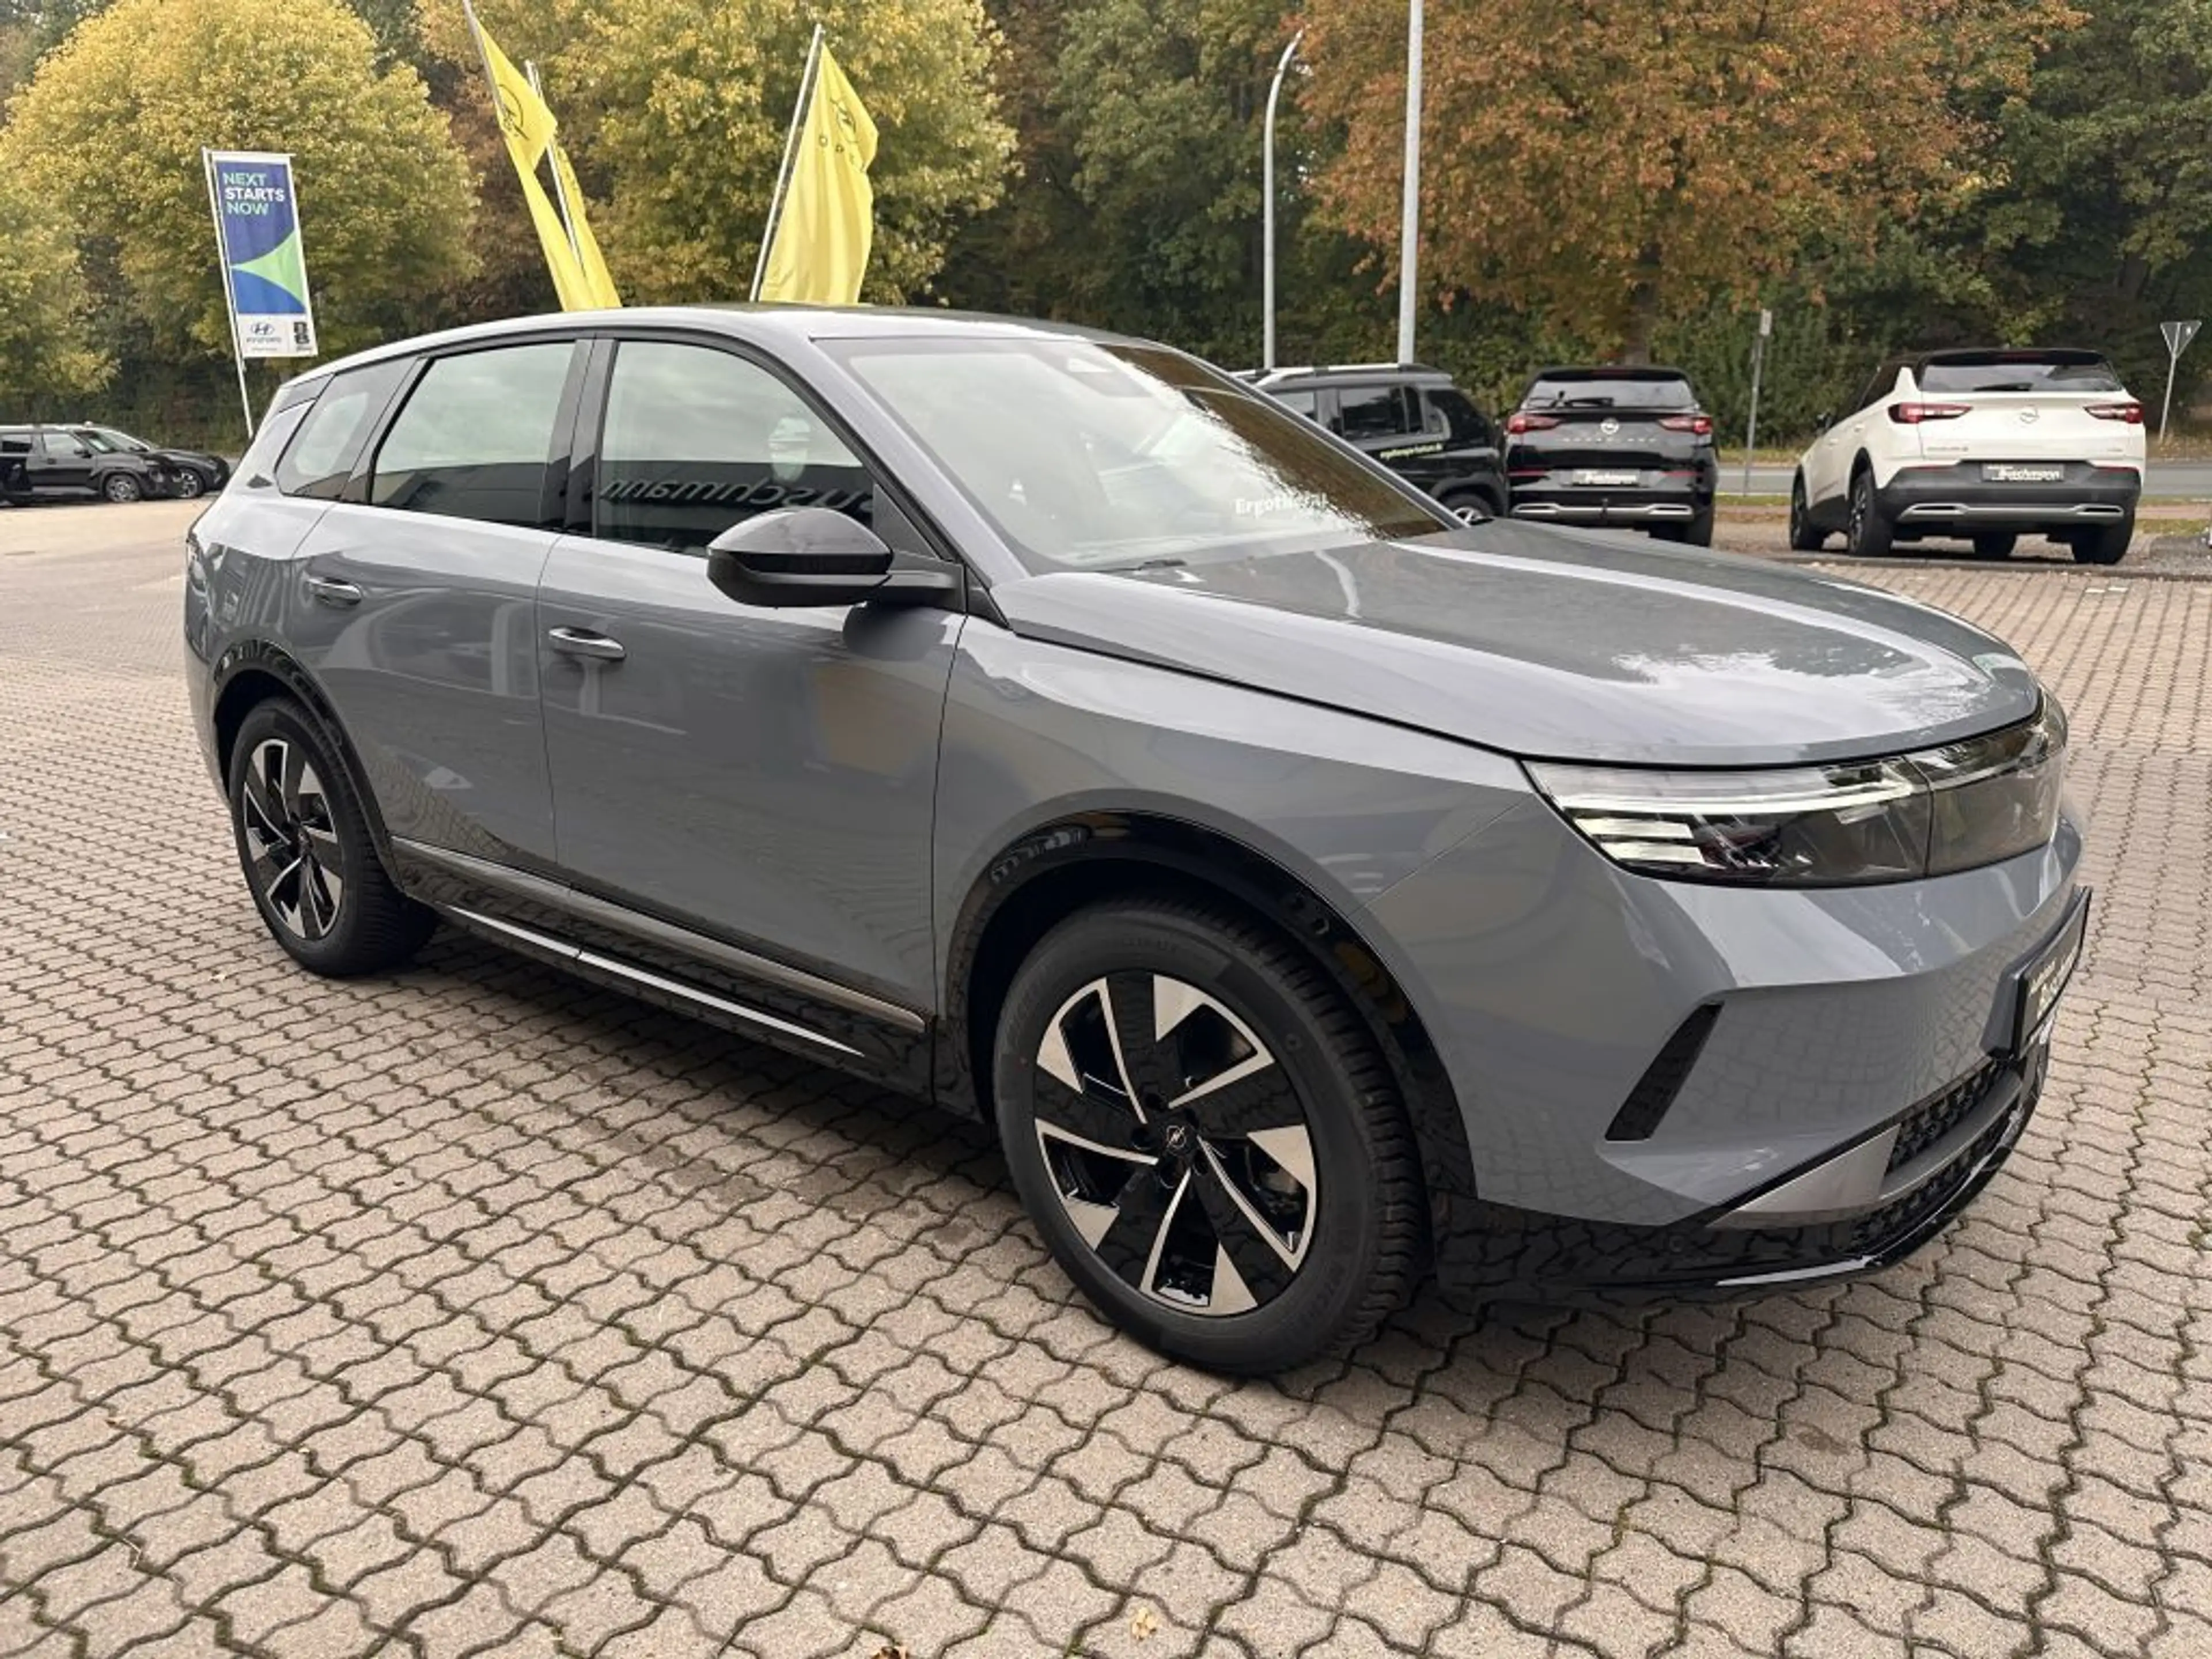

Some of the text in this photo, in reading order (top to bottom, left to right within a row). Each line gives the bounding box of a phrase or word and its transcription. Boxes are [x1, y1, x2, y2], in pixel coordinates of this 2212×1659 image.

[222, 172, 267, 186] NEXT
[225, 187, 285, 202] STARTS
[226, 201, 269, 217] NOW
